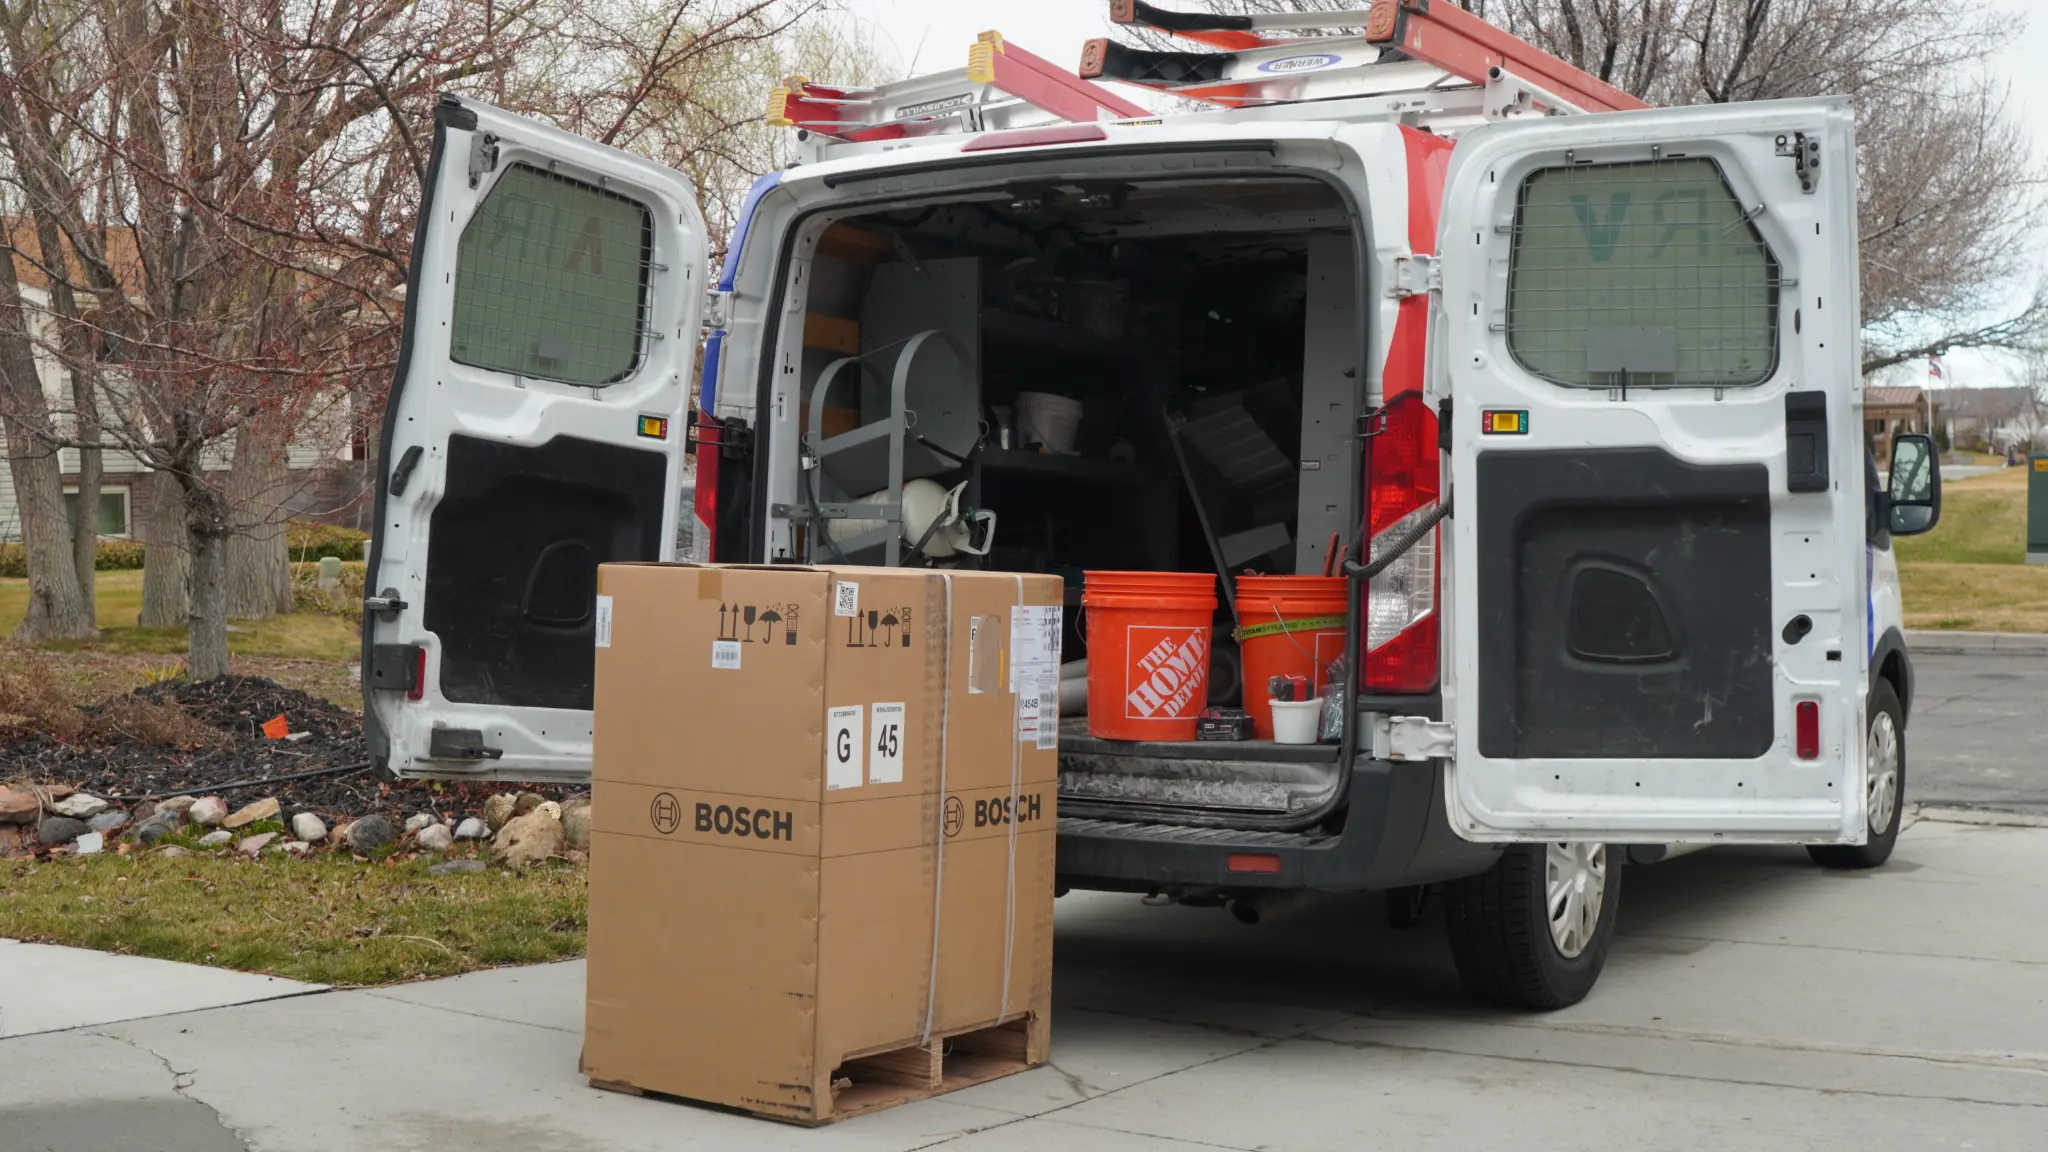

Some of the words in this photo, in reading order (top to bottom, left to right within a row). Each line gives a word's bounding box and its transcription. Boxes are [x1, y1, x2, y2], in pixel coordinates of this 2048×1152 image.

[1274, 57, 1324, 70] WERNER
[897, 98, 961, 118] LOUISVILLE
[1127, 627, 1208, 718] HOME
[1136, 636, 1178, 674] THE
[837, 727, 851, 763] G
[877, 723, 898, 758] 45
[694, 802, 793, 841] BOSCH
[975, 793, 1041, 828] BOSCH
